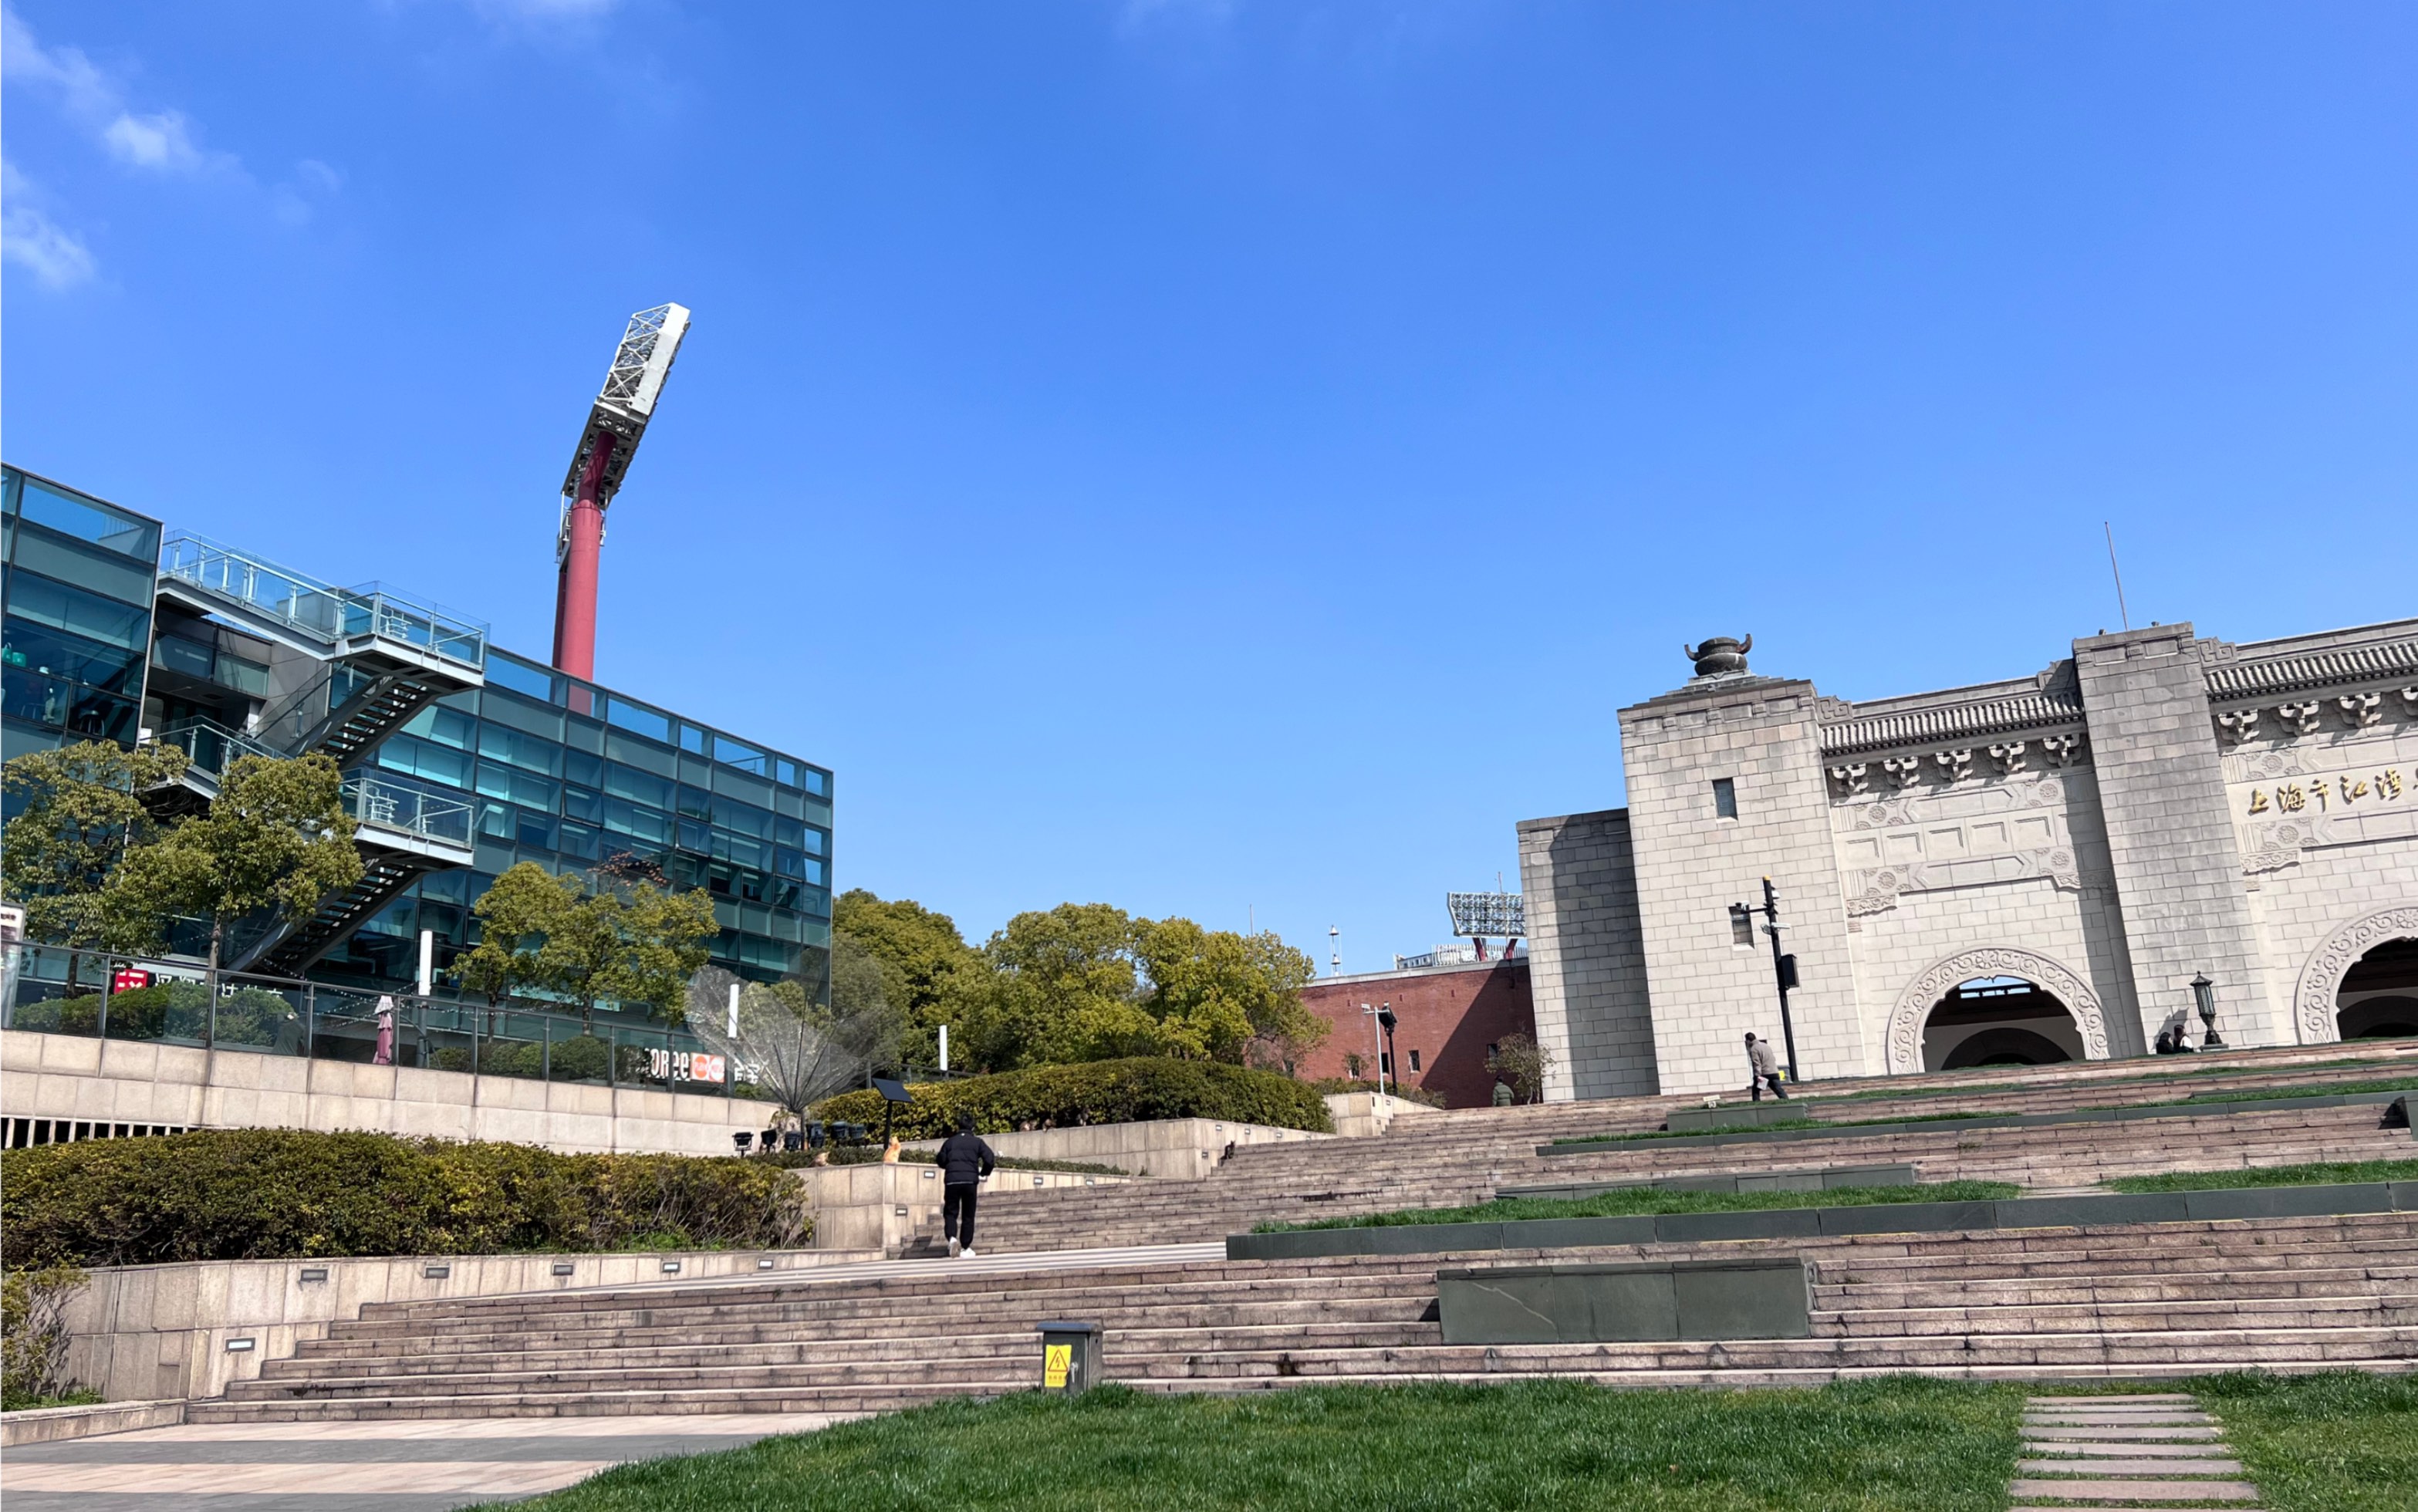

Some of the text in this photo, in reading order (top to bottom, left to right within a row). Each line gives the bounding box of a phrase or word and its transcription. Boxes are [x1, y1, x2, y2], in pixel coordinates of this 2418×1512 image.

[2248, 767, 2418, 815] 上海市江湾
